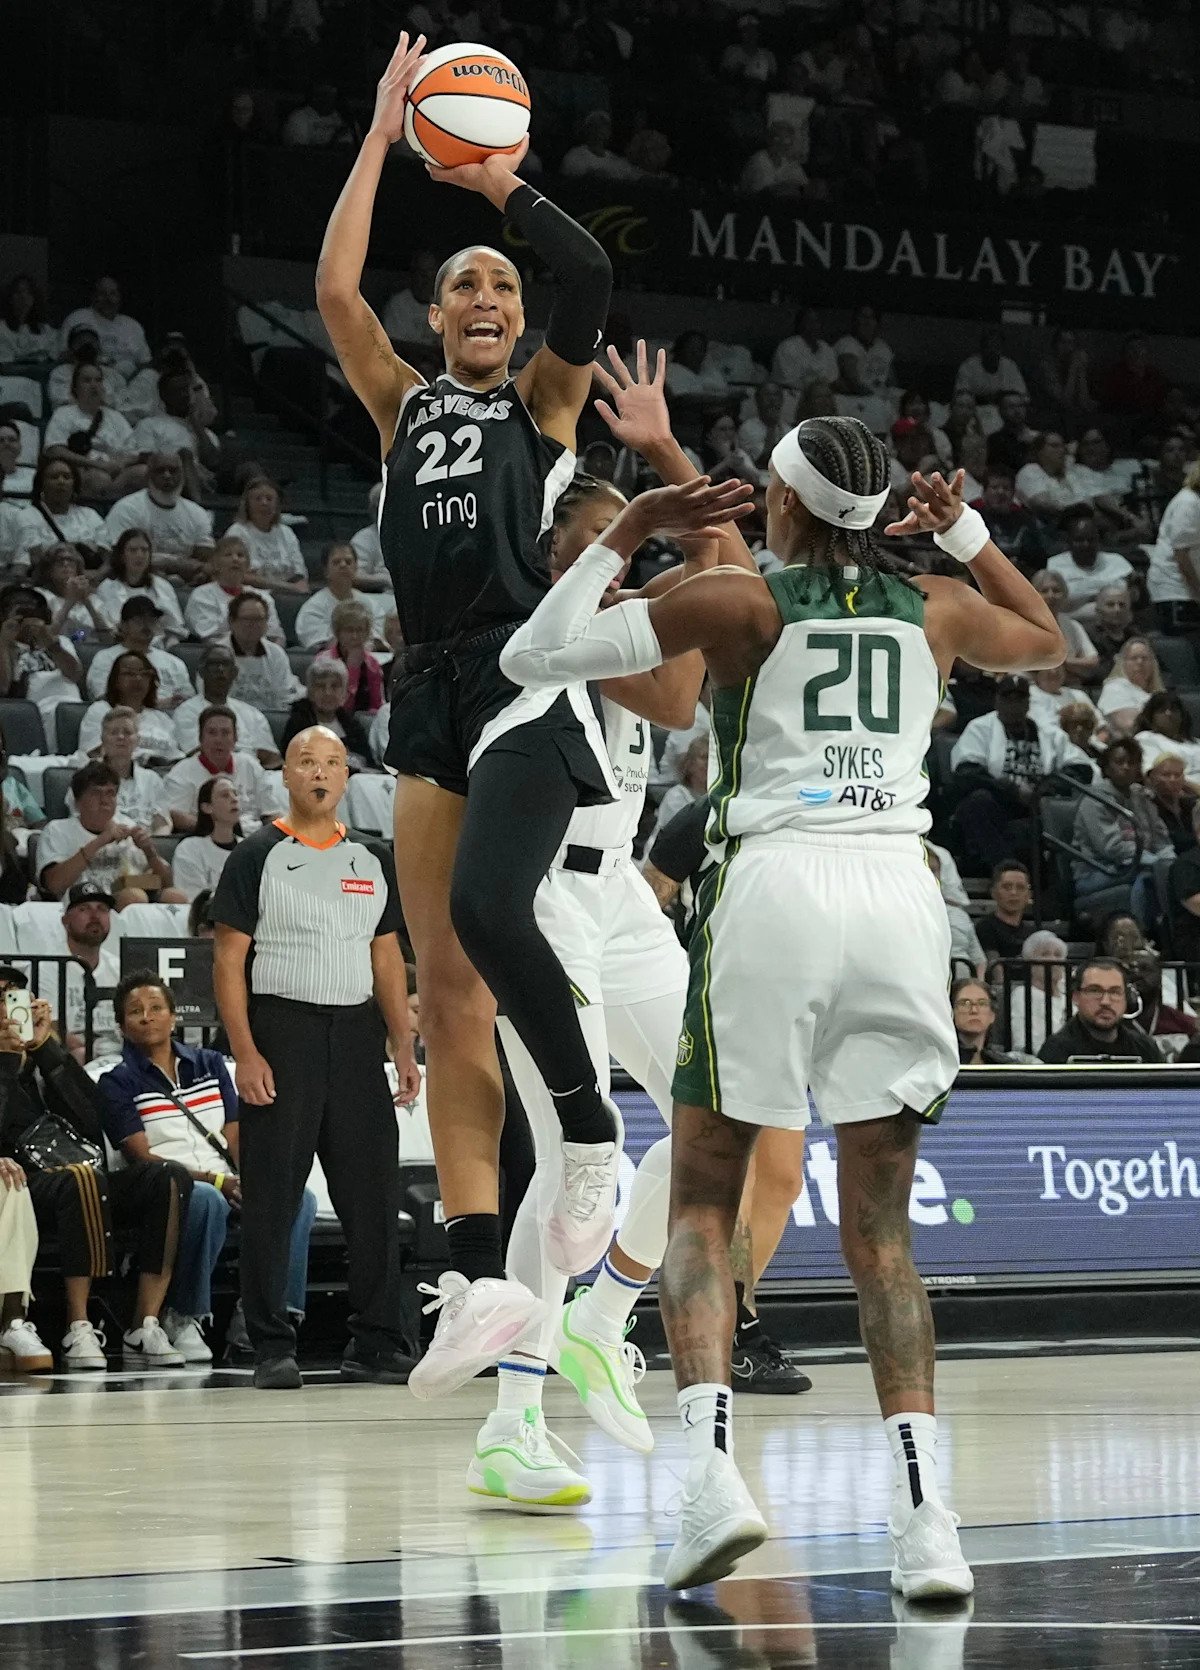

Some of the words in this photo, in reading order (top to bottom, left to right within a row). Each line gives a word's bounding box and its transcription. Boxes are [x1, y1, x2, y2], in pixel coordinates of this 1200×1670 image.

[451, 63, 527, 97] Wilson
[689, 208, 1042, 287] MANDALAY
[1063, 244, 1166, 298] BAY
[443, 394, 514, 421] VEGAS
[415, 423, 483, 486] 22
[422, 491, 478, 530] ring
[803, 633, 901, 735] 20
[823, 744, 885, 780] SYKES
[837, 784, 897, 812] AT&T
[342, 881, 374, 892] Emirates
[157, 947, 187, 988] F
[174, 1005, 201, 1014] ULTRA
[1027, 1140, 1200, 1216] Togeth
